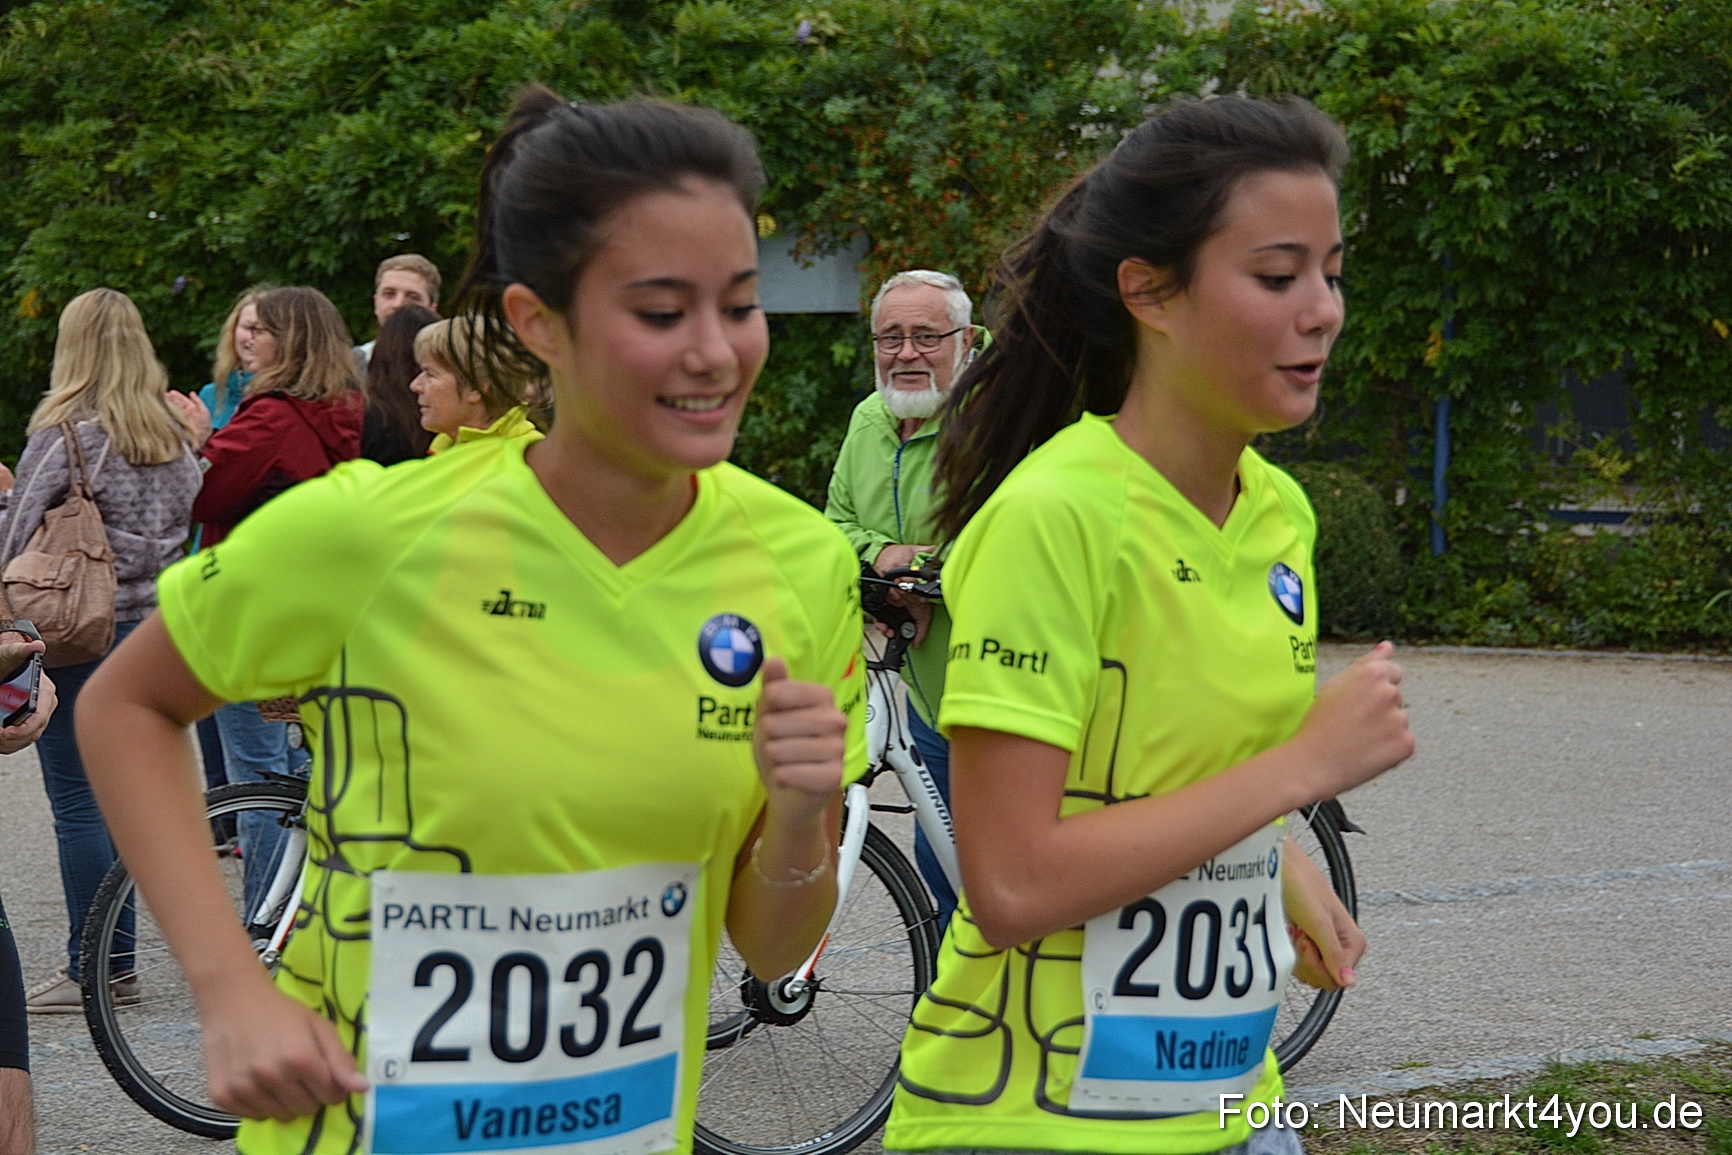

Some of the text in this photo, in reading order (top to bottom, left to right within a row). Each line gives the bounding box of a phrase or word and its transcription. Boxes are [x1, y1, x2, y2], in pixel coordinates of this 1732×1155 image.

[980, 638, 1048, 674] Partl
[698, 696, 752, 726] Part
[1199, 857, 1265, 881] Neumarkt
[383, 897, 649, 931] PARTL Neumarkt
[1112, 894, 1277, 1000] 2031
[410, 935, 665, 1063] 2032
[1156, 1030, 1250, 1071] Nadine
[453, 1092, 622, 1141] Vanessa
